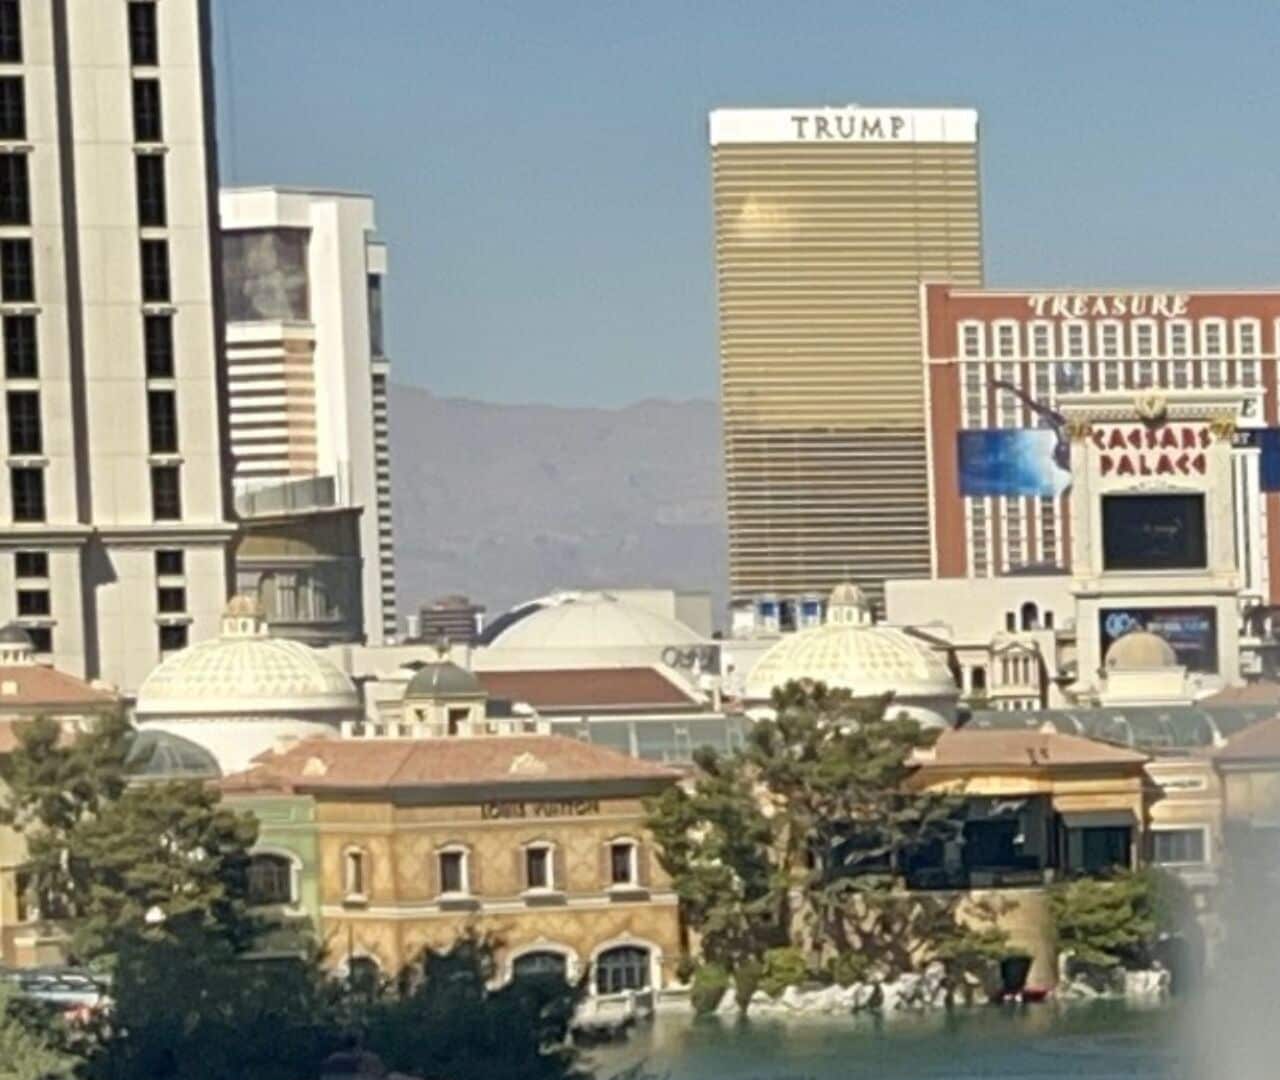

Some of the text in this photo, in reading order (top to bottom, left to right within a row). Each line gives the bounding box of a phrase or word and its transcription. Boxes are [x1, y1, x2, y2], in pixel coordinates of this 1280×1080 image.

[791, 115, 906, 139] TRUMP
[1028, 293, 1191, 318] TREASURE
[1091, 427, 1212, 450] CAESARS
[1100, 453, 1207, 477] PALACE
